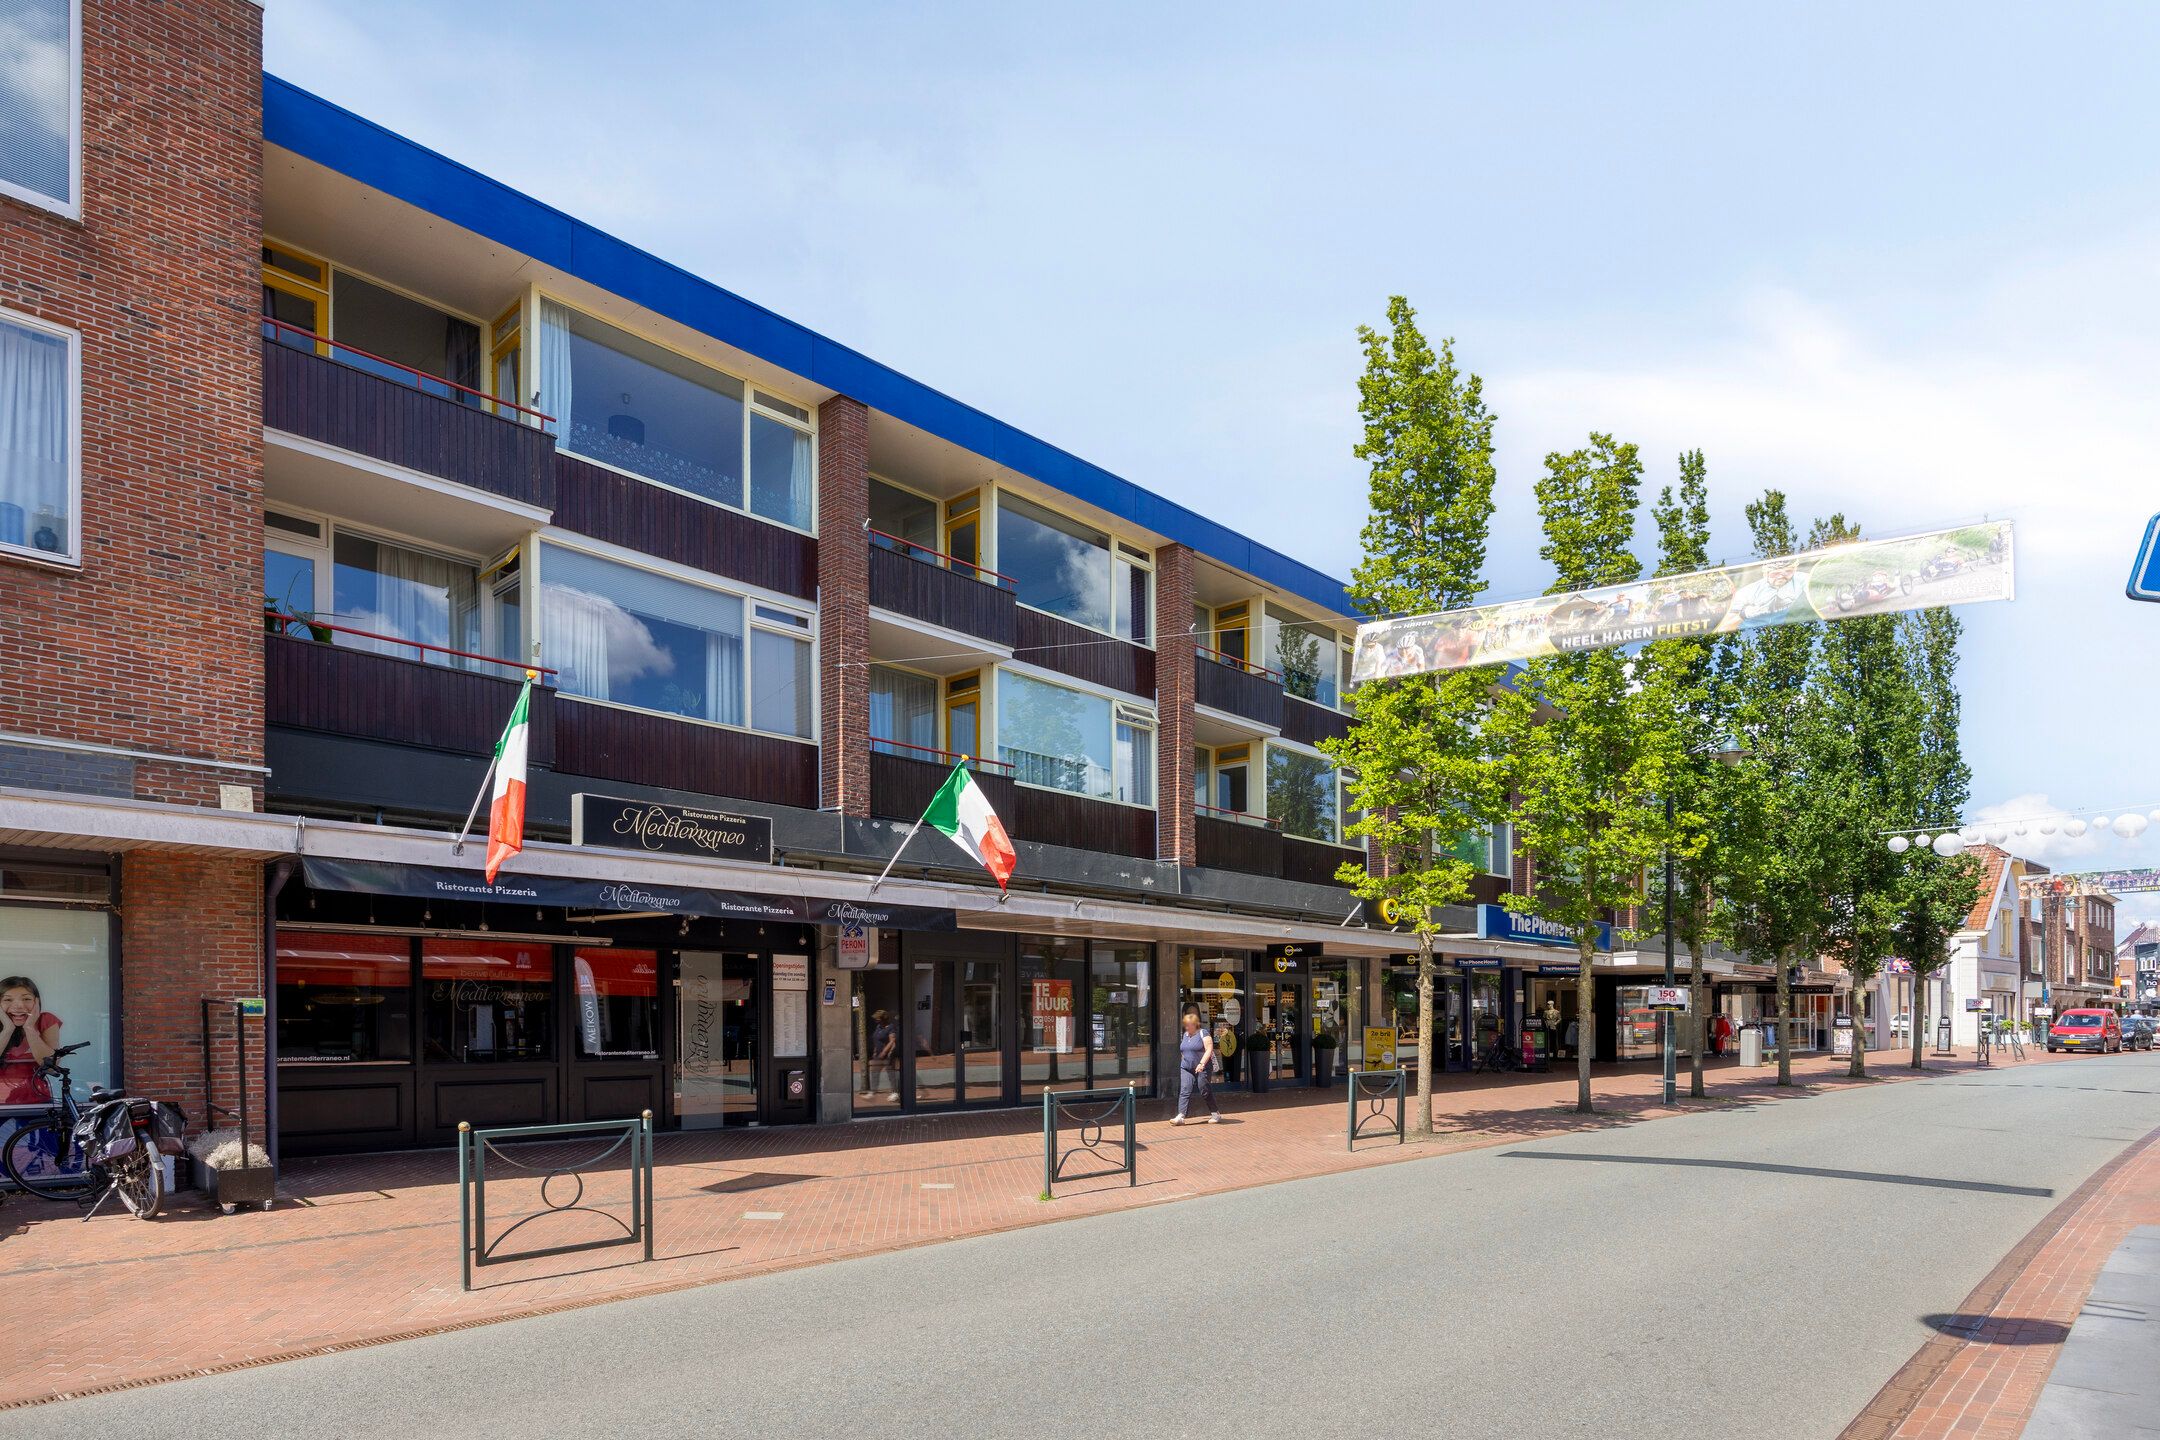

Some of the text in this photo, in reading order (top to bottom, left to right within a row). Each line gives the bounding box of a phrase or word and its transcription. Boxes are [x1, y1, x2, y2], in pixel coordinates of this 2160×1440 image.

[1404, 620, 1433, 629] HAREN
[1562, 619, 1710, 649] HEEL HAREN FIETST
[682, 809, 746, 824] Ristorante Pizzeria
[613, 805, 745, 852] Mediterraneo
[436, 881, 537, 897] Ristorante Pizzeria
[600, 884, 680, 910] Mediterraneo
[721, 902, 794, 915] Ristorante Pizzeria
[841, 939, 866, 949] PERONI
[432, 978, 544, 1012] Mediterraneo
[1033, 982, 1050, 997] TE
[1659, 989, 1676, 998] 150
[1035, 997, 1069, 1011] HUUR
